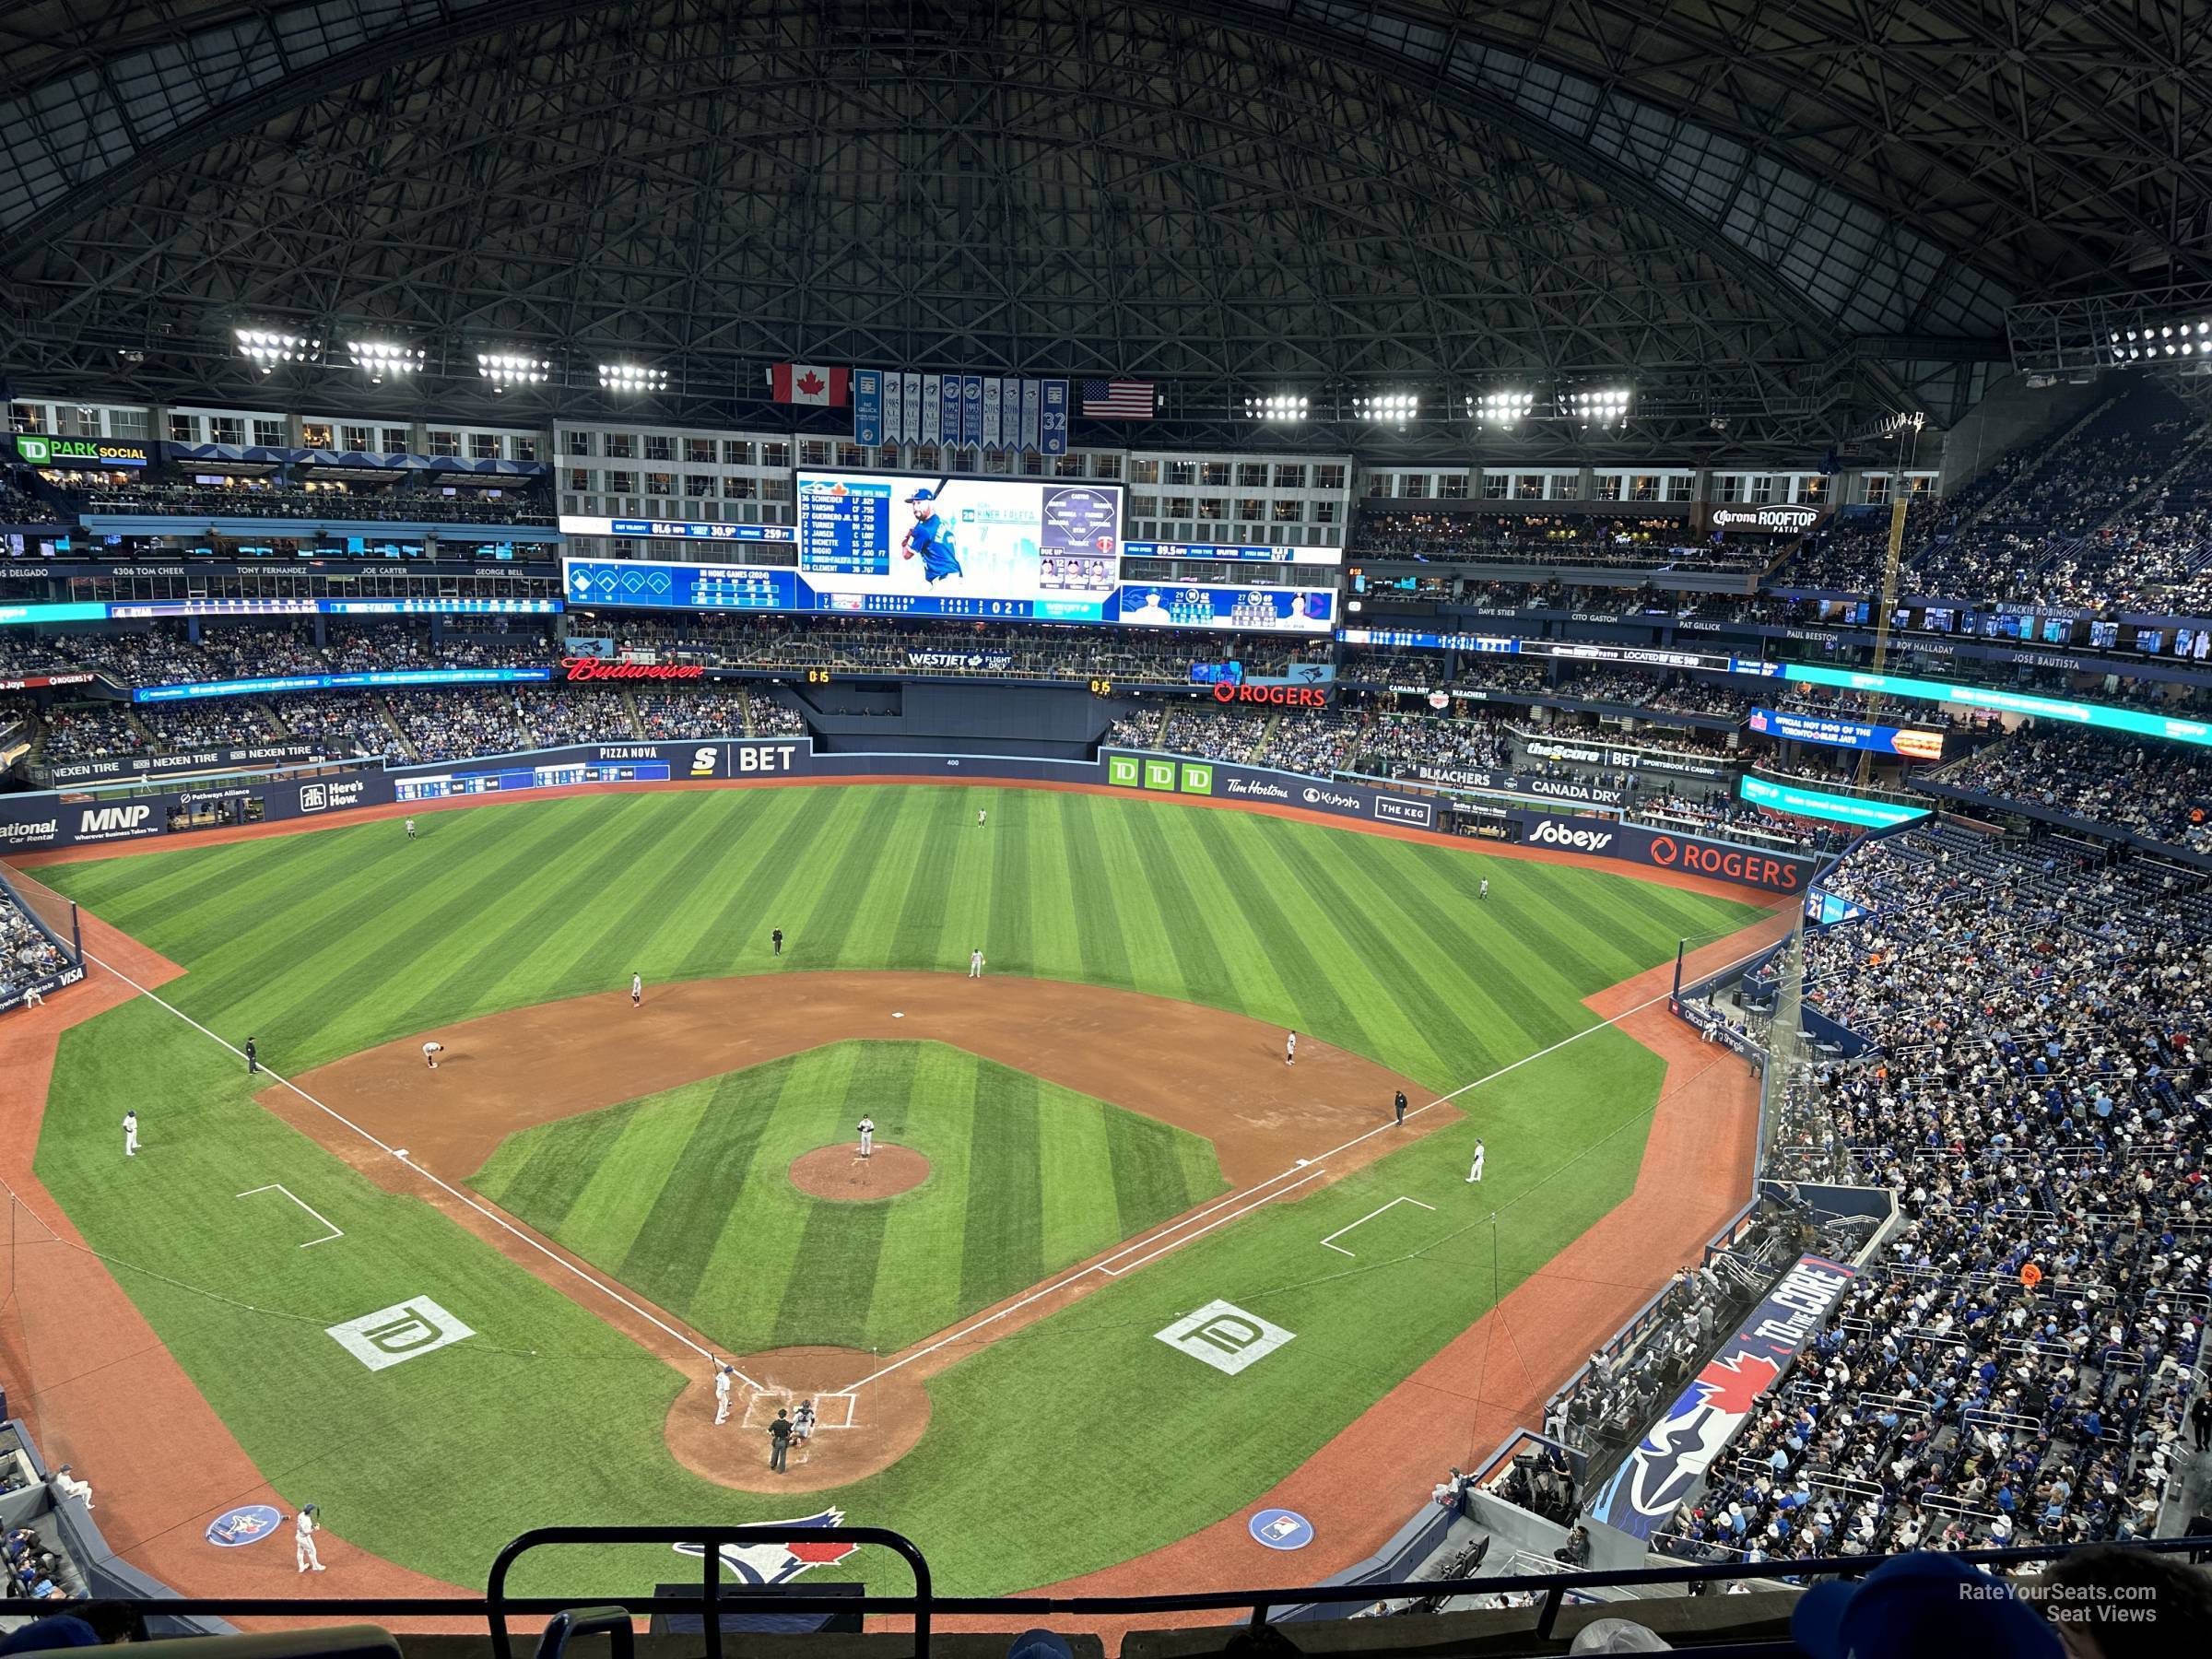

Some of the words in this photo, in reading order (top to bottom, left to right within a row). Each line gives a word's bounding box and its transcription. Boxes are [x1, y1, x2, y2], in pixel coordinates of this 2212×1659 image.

[886, 398, 899, 408] 1985
[905, 399, 918, 409] 1989
[924, 401, 937, 411] 1991
[945, 402, 958, 412] 1992
[966, 403, 979, 413] 1993
[985, 404, 998, 414] 2015
[1043, 412, 1065, 429] 32
[20, 441, 47, 458] TD
[51, 441, 98, 456] PARK
[100, 447, 147, 459] SOCIAL
[1712, 509, 1757, 526] Corona
[1759, 512, 1818, 526] ROOFTOP
[652, 524, 671, 535] 81.6
[764, 529, 782, 538] 259
[1157, 546, 1175, 555] 89.5
[10, 569, 48, 577] DELGADO
[151, 567, 184, 575] CHEEK
[237, 567, 259, 575] TONY
[262, 566, 307, 575] FERNANDEZ
[476, 568, 505, 576] GEORGE
[708, 570, 725, 578] HOME
[726, 570, 747, 579] GAMES
[1478, 607, 1495, 616] DAVE
[1497, 608, 1515, 617] STIEB
[1589, 614, 1618, 623] GASTON
[2006, 604, 2034, 616] JACKIE
[2035, 606, 2081, 619] ROBINSON
[1679, 620, 1692, 629] PAT
[1694, 621, 1720, 631] GILLICK
[1786, 630, 1805, 640] PAUL
[1805, 631, 1838, 642] BEESTON
[1897, 640, 1912, 651] ROY
[1913, 641, 1954, 655] HALLADAY
[909, 653, 968, 665] WESTJET
[1624, 651, 1658, 662] LOCATED
[1668, 654, 1683, 664] SEC
[2012, 651, 2033, 664] JOSÉ
[2037, 656, 2079, 670] BAUTISTA
[560, 656, 704, 680] Budweiser
[57, 675, 83, 684] ROGERS
[809, 671, 829, 683] 0:15
[6, 680, 25, 689] Jays
[1091, 680, 1110, 693] 0:15
[1240, 684, 1325, 707] ROGERS
[1388, 685, 1416, 693] CANADA
[1453, 689, 1488, 699] BLEACHERS
[1775, 717, 1801, 728] OFFICIAL
[1803, 721, 1819, 730] HOT
[1821, 721, 1840, 732] DOG
[1841, 724, 1854, 734] OF
[1856, 726, 1871, 736] THE
[1782, 726, 1813, 738] TORONTO
[1819, 732, 1838, 742] BLUE
[1839, 734, 1857, 745] JAYS
[599, 747, 629, 759] PIZZA
[630, 747, 656, 759] NOVA
[739, 746, 796, 772] BET
[1526, 743, 1600, 762] theScore
[1613, 752, 1641, 768] BET
[1642, 760, 1683, 771] SPORTSBOOK
[1690, 765, 1715, 775] CASINO
[53, 767, 90, 778] NEXEN
[92, 762, 120, 772] TIRE
[153, 756, 192, 767] NEXEN
[194, 753, 218, 763] TIRE
[249, 747, 285, 759] NEXEN
[288, 746, 312, 756] TIRE
[1112, 761, 1135, 779] TD
[1148, 766, 1172, 783] TD
[1185, 770, 1209, 787] TD
[328, 781, 363, 794] Here's
[1227, 778, 1246, 793] Tim
[1248, 780, 1288, 799] Hortons
[1532, 782, 1589, 800] CANADA
[329, 794, 358, 806] How.
[1322, 793, 1360, 810] Kubota
[1381, 804, 1401, 816] THE
[1405, 807, 1425, 818] KEG
[80, 806, 150, 833] MNP
[9, 836, 25, 844] Car
[26, 833, 53, 842] Rental
[74, 832, 105, 841] Wherever
[105, 830, 130, 839] Business
[1530, 820, 1612, 852] Sobeys
[1683, 844, 1797, 888] ROGERS
[1808, 900, 1822, 920] 21
[59, 968, 83, 986] VISA
[1685, 1010, 1702, 1026] Official
[1724, 1033, 1744, 1053] Shingle
[1771, 1263, 1847, 1314] CORE
[1786, 1311, 1818, 1329] THE
[360, 1306, 442, 1353] TD
[1177, 1314, 1265, 1355] TD
[1754, 1320, 1805, 1346] TO
